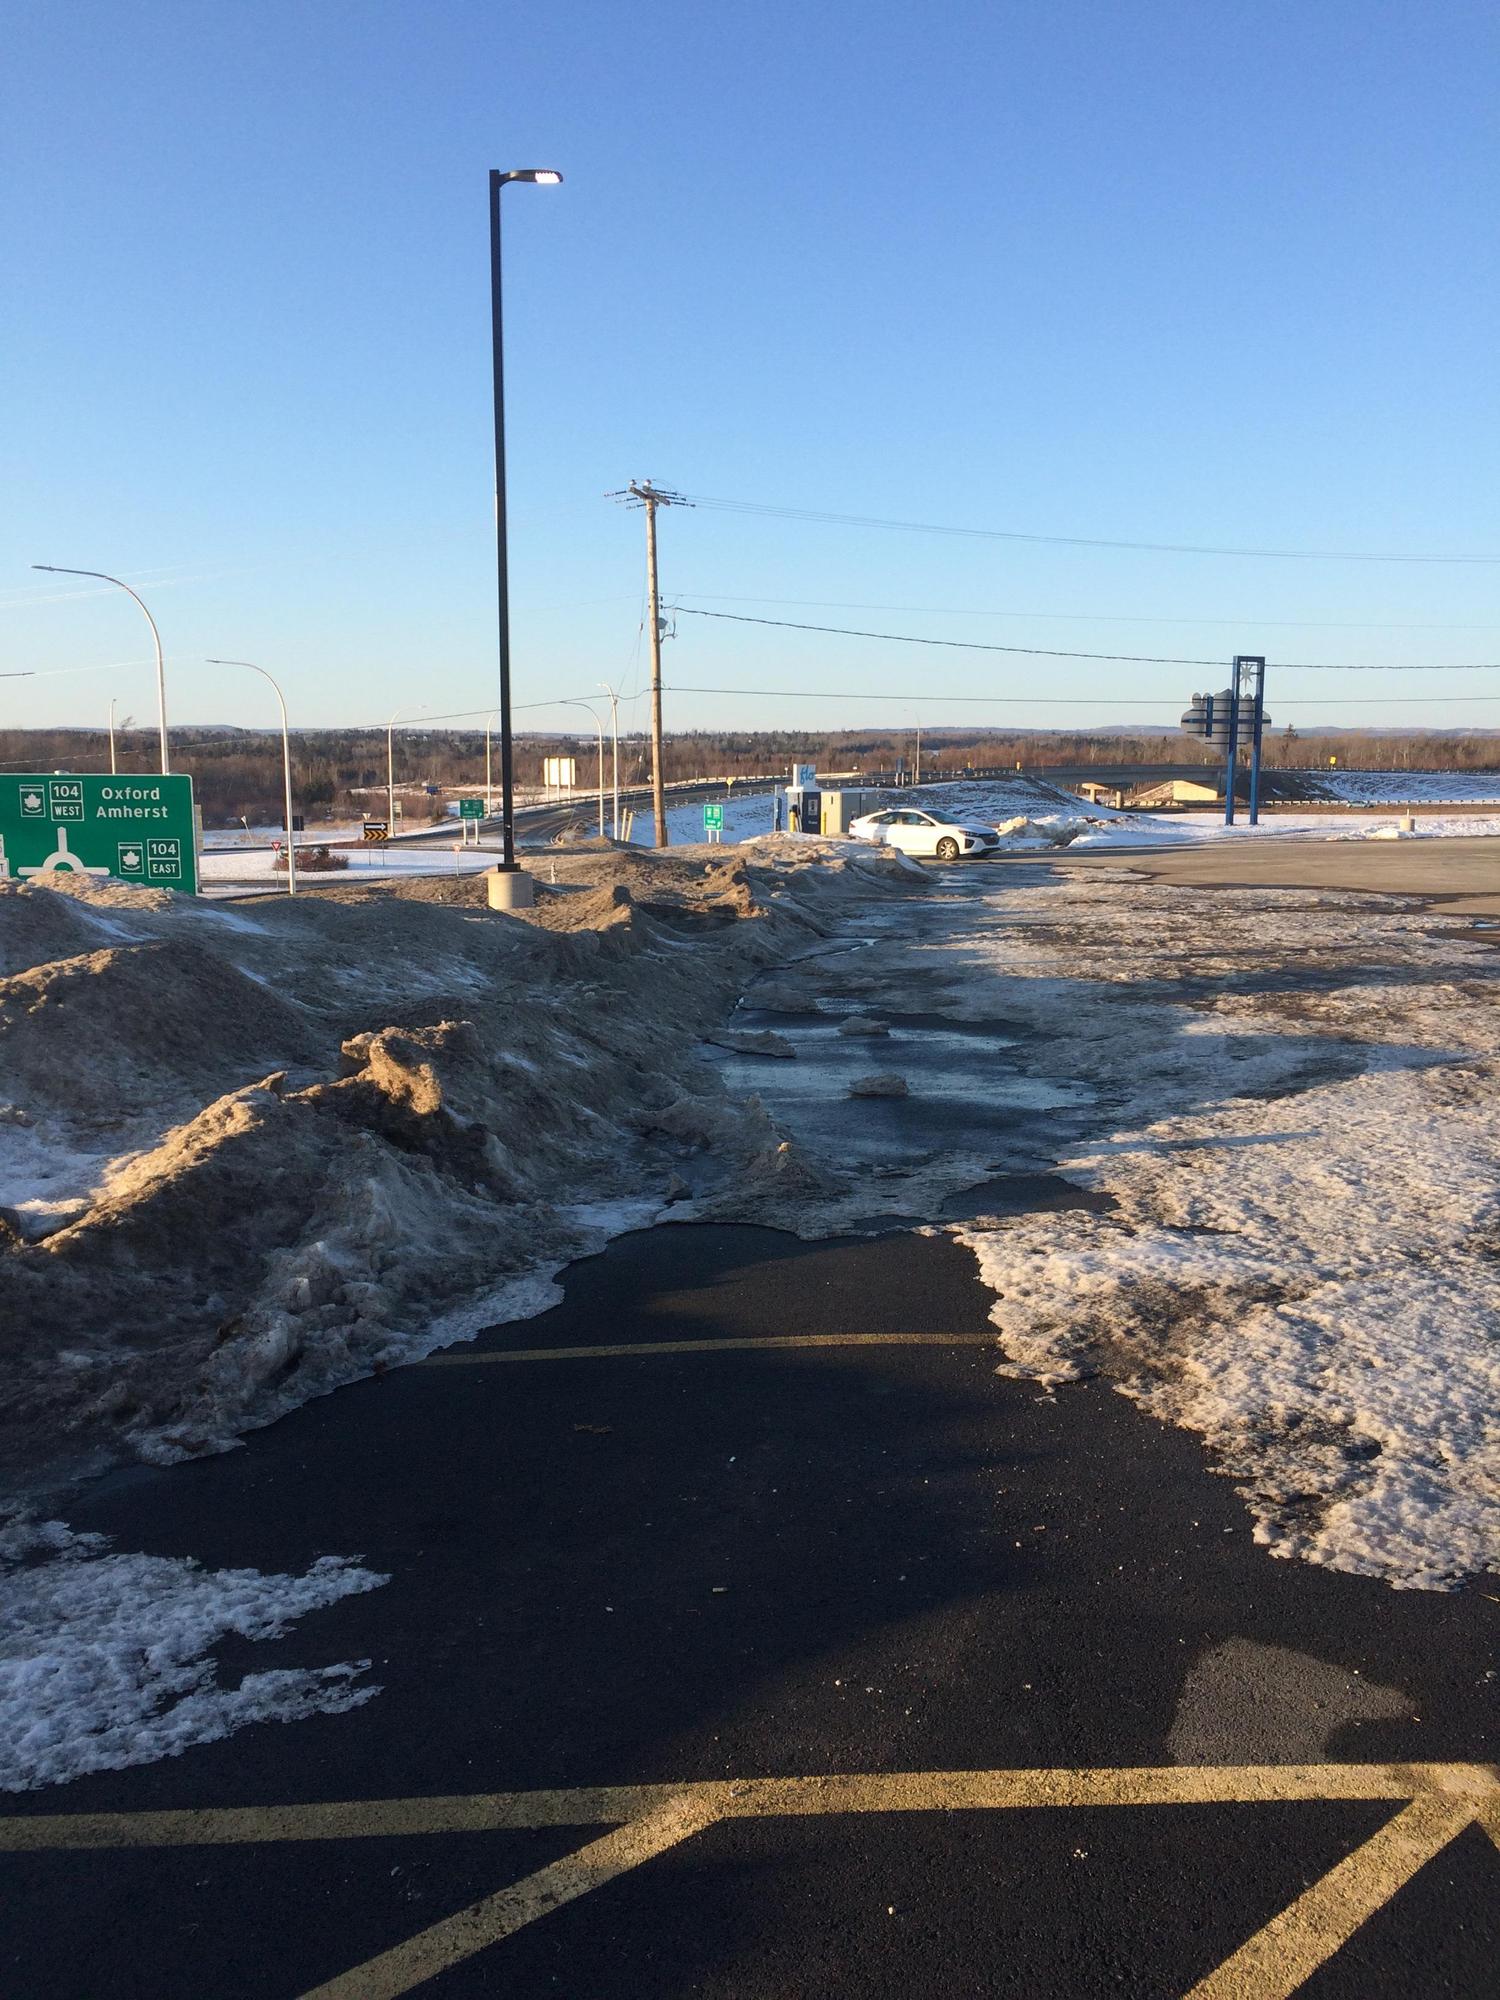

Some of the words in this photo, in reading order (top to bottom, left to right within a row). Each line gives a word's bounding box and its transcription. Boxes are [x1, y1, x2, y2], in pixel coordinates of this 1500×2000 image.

[800, 765, 816, 784] flo
[53, 785, 79, 797] 104
[101, 787, 161, 800] Oxford
[54, 806, 80, 816] WEST
[96, 805, 168, 818] Amherst
[151, 843, 177, 855] 104
[152, 863, 176, 874] EAST
